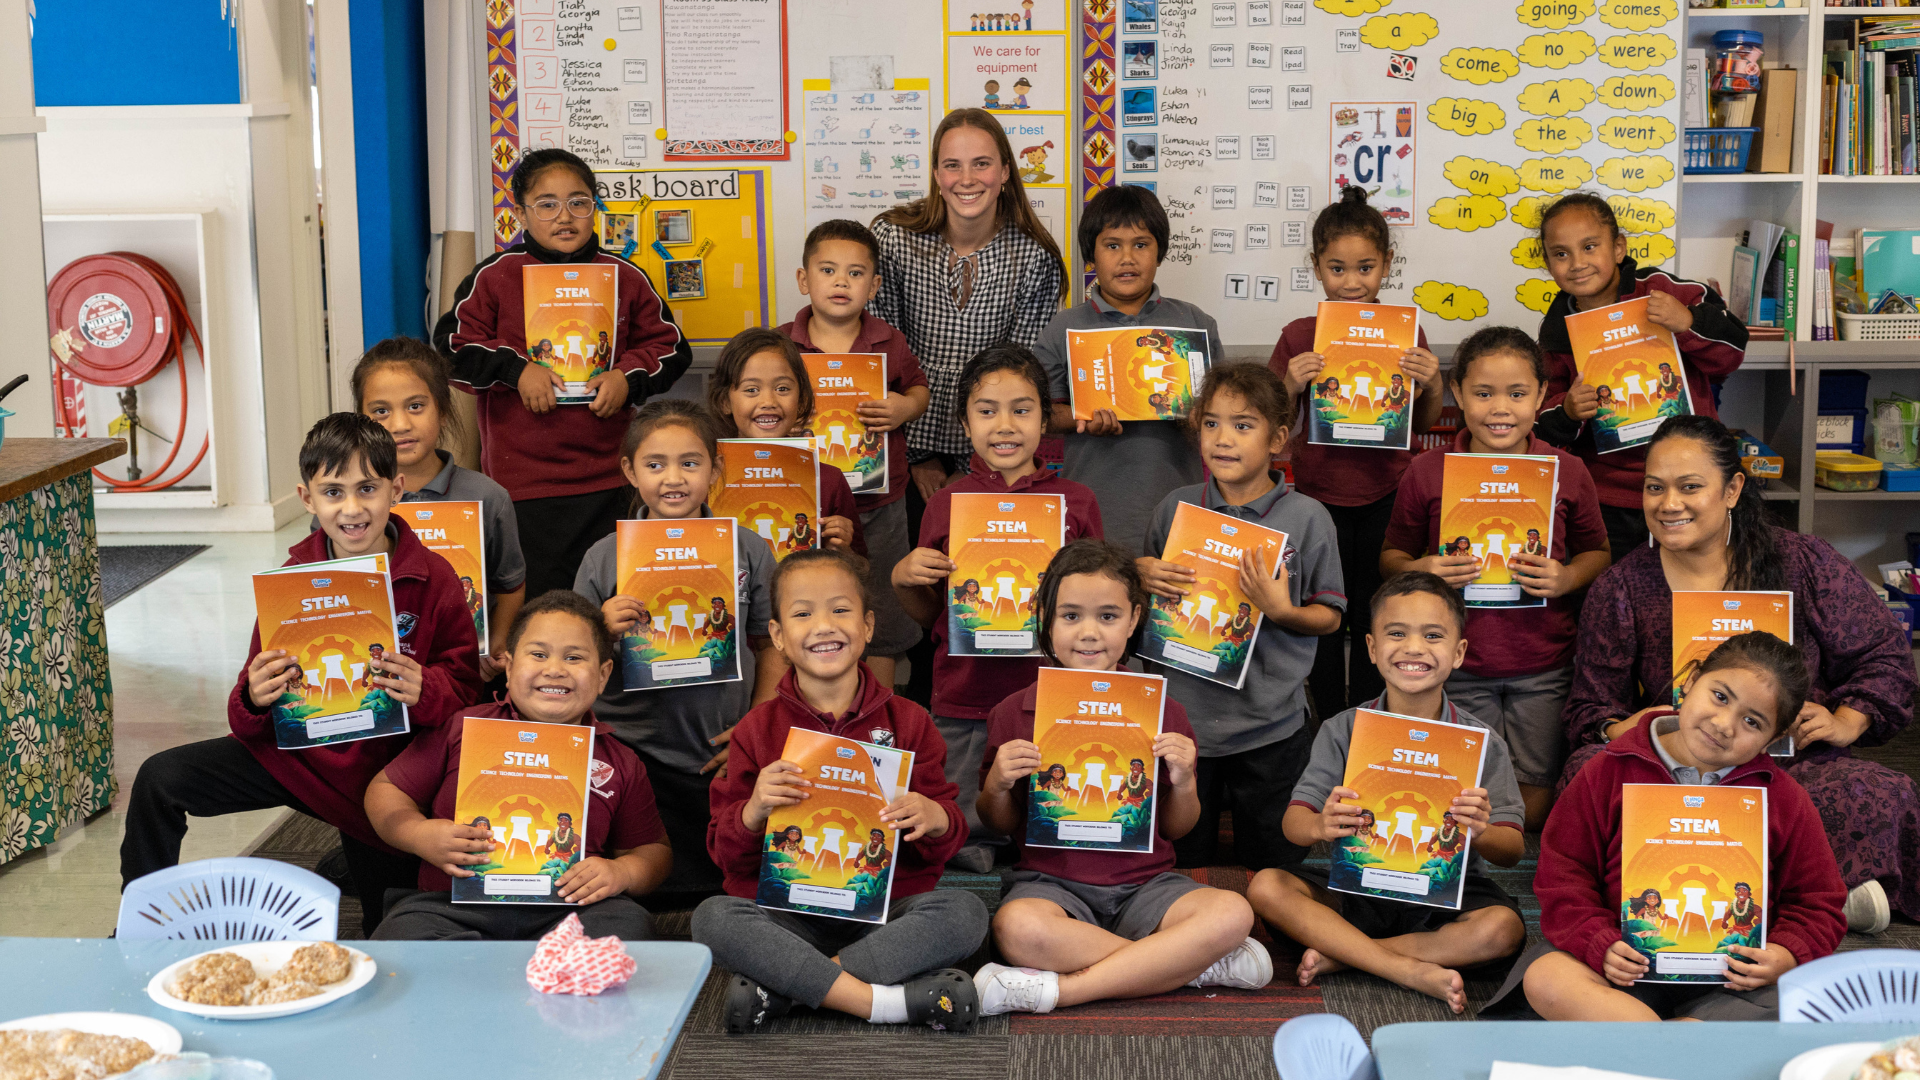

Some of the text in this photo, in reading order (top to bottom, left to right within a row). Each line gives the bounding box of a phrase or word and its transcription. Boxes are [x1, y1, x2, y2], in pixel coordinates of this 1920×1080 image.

[1159, 5, 1197, 20] Georgia
[1213, 4, 1235, 12] Group
[1531, 1, 1577, 21] going
[1613, 3, 1661, 16] comes
[558, 9, 600, 21] Georgia
[1285, 15, 1302, 23] ipad
[532, 25, 547, 42] 2
[556, 31, 584, 40] Linda
[1160, 29, 1186, 38] Tiah
[1391, 26, 1401, 38] a
[557, 39, 584, 47] Jirah
[1162, 42, 1192, 54] Linda
[1250, 44, 1270, 52] Book
[1339, 42, 1357, 50] Tray
[1544, 43, 1564, 56] no
[973, 45, 1041, 56] We care for
[1613, 45, 1656, 57] were
[561, 59, 602, 69] Jessica
[1251, 57, 1266, 65] Box
[1285, 61, 1302, 69] ipad
[1456, 57, 1500, 73] come
[534, 61, 547, 80] 3
[561, 68, 600, 78] Ahleena
[976, 62, 1038, 75] equipment
[1162, 85, 1188, 96] Luka
[1548, 88, 1560, 103] A
[1612, 81, 1657, 98] down
[535, 97, 552, 115] 4
[1160, 100, 1190, 112] Eshan
[1291, 99, 1308, 107] ipad
[569, 113, 604, 121] Roman
[1161, 113, 1198, 125] Ahleena
[1450, 104, 1477, 128] big
[1004, 124, 1044, 135] ur best
[1537, 124, 1567, 140] the
[1613, 126, 1656, 140] went
[540, 131, 555, 149] 5
[568, 145, 612, 156] Tamiyah
[1160, 146, 1194, 156] Roman
[1353, 144, 1392, 184] cr
[1469, 170, 1489, 184] on
[1539, 167, 1564, 180] me
[1621, 167, 1645, 179] we
[652, 172, 736, 198] board
[1163, 195, 1196, 210] Jessica
[1258, 195, 1275, 203] Tray
[1458, 203, 1472, 218] in
[1612, 202, 1656, 224] when
[1626, 242, 1649, 259] nd
[555, 287, 590, 298] STEM
[1230, 278, 1244, 294] T
[1260, 280, 1274, 296] T
[1786, 267, 1795, 318] Lots of Fruit
[1441, 292, 1454, 307] A
[87, 311, 124, 330] MARTIN
[1348, 326, 1384, 339] STEM
[1602, 324, 1640, 342] STEM
[1092, 358, 1106, 391] STEM
[818, 376, 854, 387] STEM
[744, 467, 783, 479] STEM
[1479, 482, 1519, 494] STEM
[987, 520, 1027, 533] STEM
[654, 546, 698, 561] STEM
[1203, 538, 1244, 560] STEM
[300, 594, 350, 612] STEM
[1711, 618, 1754, 631] STEM
[1078, 700, 1122, 716] STEM
[572, 735, 583, 743] YEAR
[504, 751, 549, 768] STEM
[1392, 748, 1439, 767] STEM
[819, 765, 866, 784] STEM
[1367, 763, 1385, 771] SCIENCE
[1386, 766, 1413, 774] TECHNOLOGY
[1414, 769, 1441, 778] ENGINEERING
[1742, 798, 1756, 806] YEAR
[1669, 817, 1720, 834] STEM
